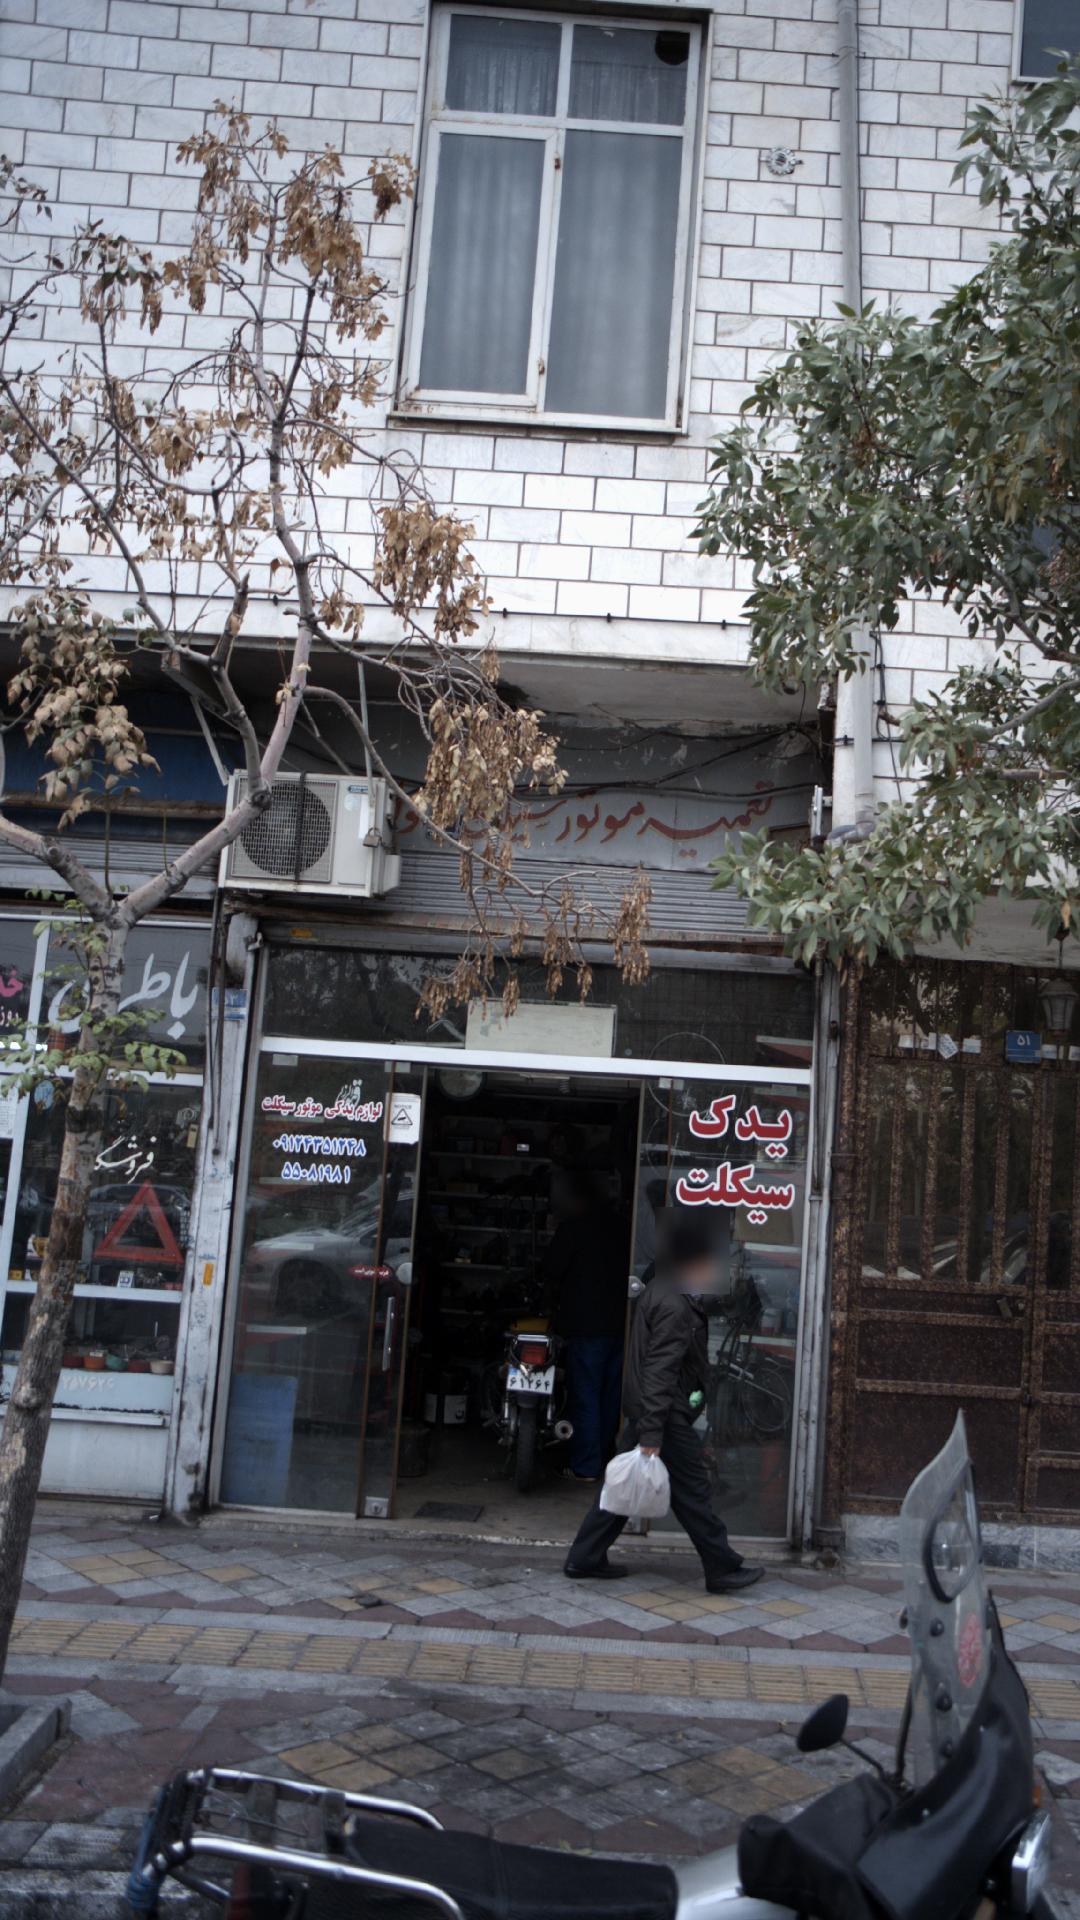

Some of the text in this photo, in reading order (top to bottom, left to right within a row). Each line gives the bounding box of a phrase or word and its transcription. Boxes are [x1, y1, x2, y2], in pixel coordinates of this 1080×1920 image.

[1016, 1033, 1032, 1046] ۵۱
[261, 1094, 383, 1123] لوازم یدکی موتور سیکلت
[689, 1094, 793, 1158] یدک
[281, 1161, 352, 1185] ۵۵۰۸۱۹۸۱
[675, 1161, 796, 1225] سیکلت
